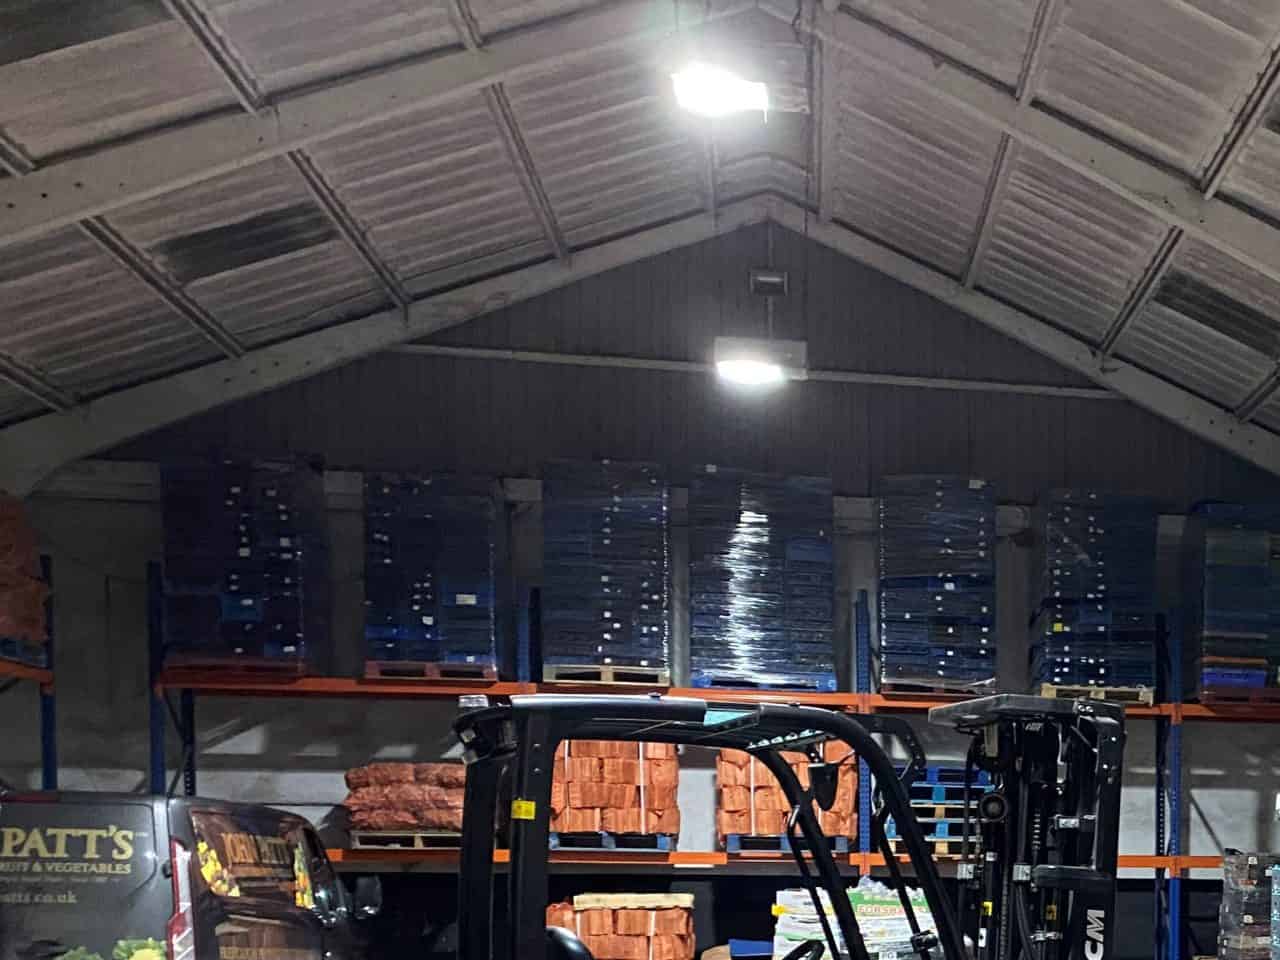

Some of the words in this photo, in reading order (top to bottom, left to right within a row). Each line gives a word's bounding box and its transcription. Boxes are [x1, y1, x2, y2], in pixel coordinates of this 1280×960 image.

[0, 825, 134, 860] PATT'S
[32, 862, 42, 873] &
[46, 862, 132, 875] VEGETABLES
